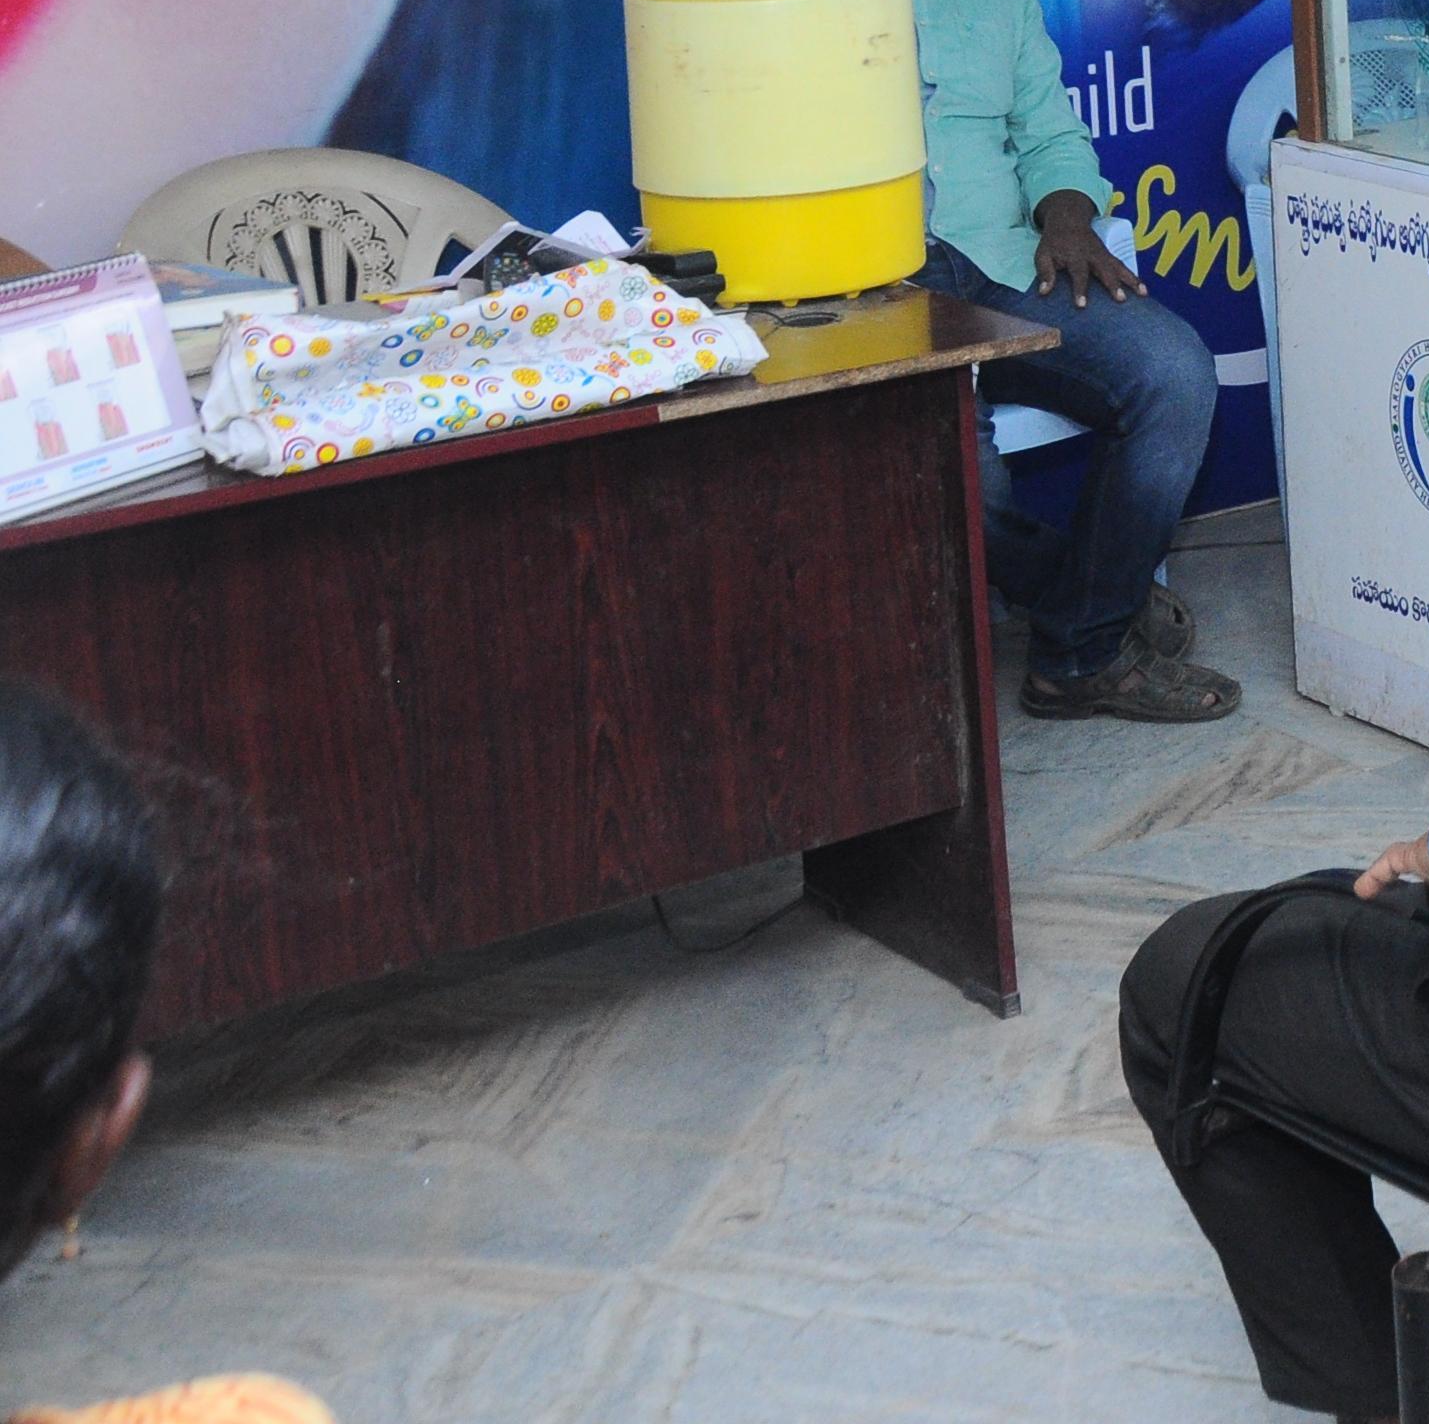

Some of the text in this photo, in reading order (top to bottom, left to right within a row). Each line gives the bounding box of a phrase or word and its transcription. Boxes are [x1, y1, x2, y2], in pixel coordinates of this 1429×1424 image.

[1390, 345, 1422, 424] AAROGYASRI
[1393, 434, 1420, 492] QUALITY
[1352, 576, 1409, 617] సహాయం
